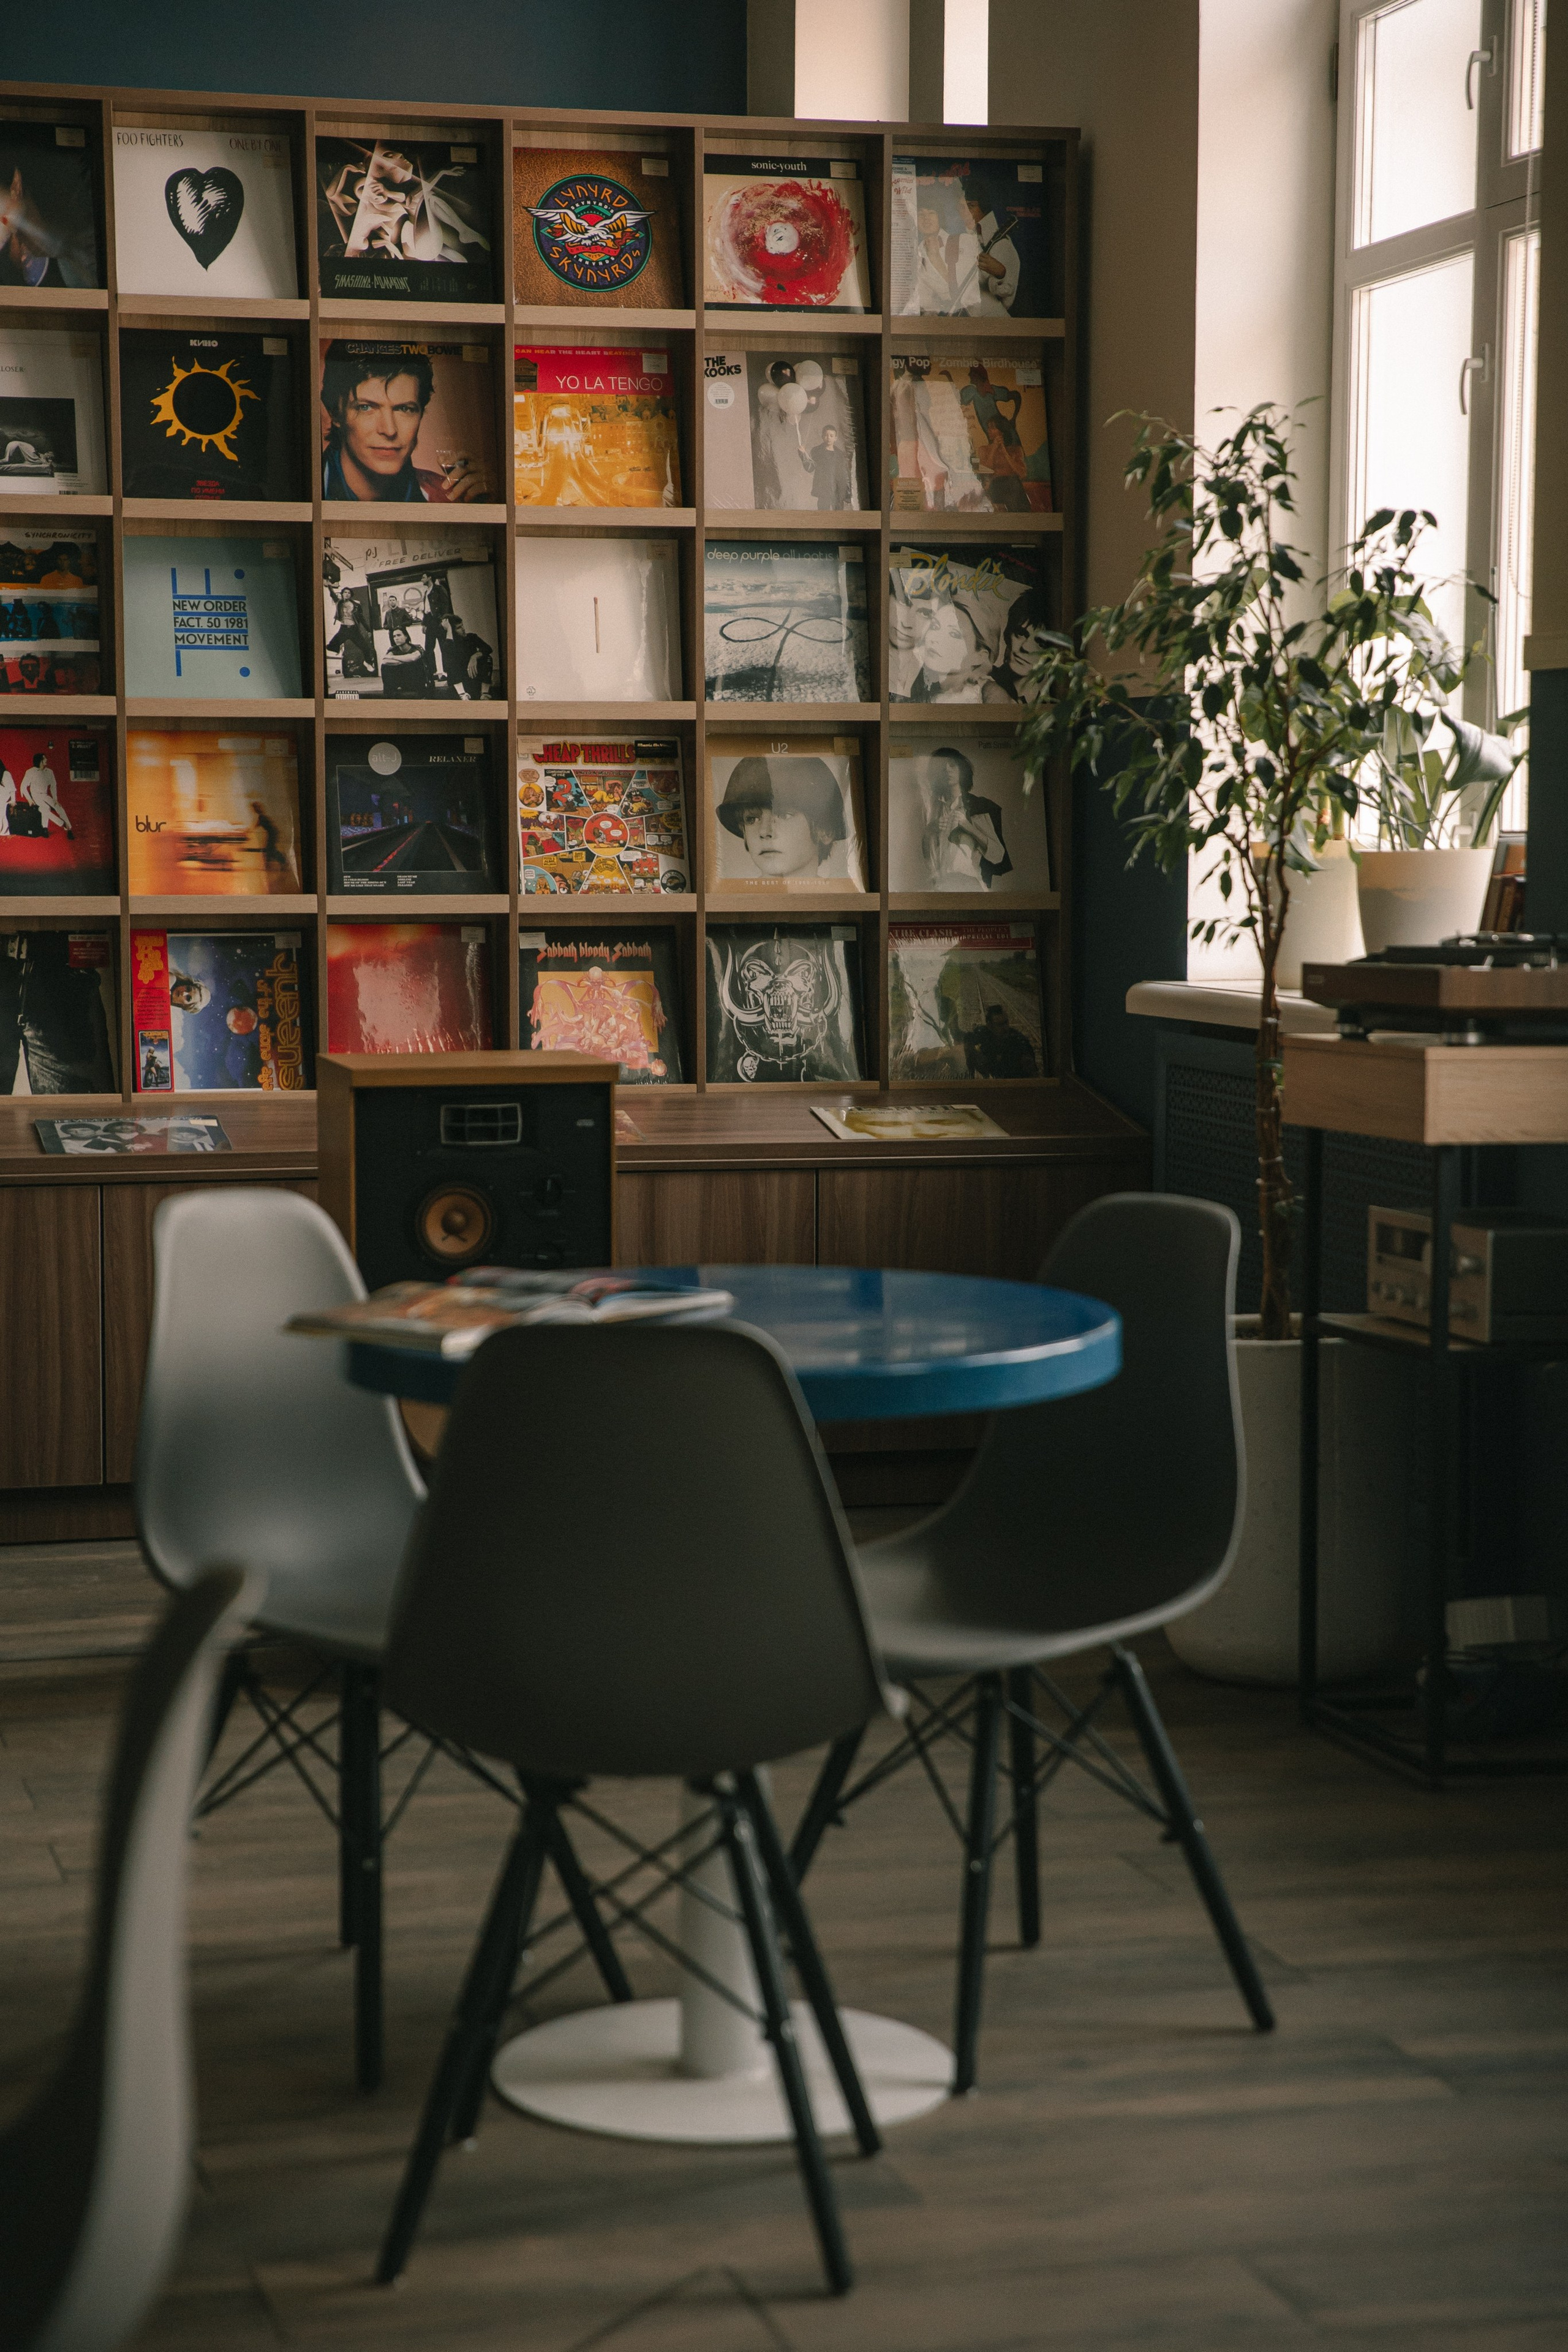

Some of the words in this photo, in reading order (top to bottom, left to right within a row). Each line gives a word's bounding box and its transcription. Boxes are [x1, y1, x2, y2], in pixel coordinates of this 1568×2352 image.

[117, 132, 138, 146] FOO
[140, 133, 183, 148] FIGHTERS
[229, 137, 249, 151] ONE
[250, 140, 262, 151] BY
[263, 138, 282, 153] ONE
[752, 160, 807, 172] sonic-youth
[554, 184, 628, 208] LYNYRD
[571, 200, 614, 214] SKYNYRD'S
[334, 274, 372, 289] SMASHING
[704, 356, 726, 367] THE
[909, 357, 930, 368] Pop
[556, 375, 579, 390] YO
[584, 376, 605, 390] LA
[608, 376, 663, 391] TENGO
[378, 557, 406, 568] FREE
[707, 548, 738, 564] deep
[740, 549, 780, 564] purple
[905, 553, 1010, 601] Blondie
[173, 600, 201, 611] NEW
[203, 600, 247, 611] ORDER
[173, 616, 203, 628] FACT.
[206, 617, 221, 628] 50
[224, 617, 248, 628] 1981
[175, 633, 249, 645] MOVEMENT
[581, 744, 636, 764] THRILLS
[771, 742, 789, 754] U2
[372, 753, 397, 763] alt-J
[135, 815, 167, 832] blur
[919, 929, 953, 937] CLASH
[536, 941, 578, 963] Sabbath
[579, 941, 610, 963] bloody
[612, 941, 652, 963] Sabbath
[265, 952, 304, 1090] queens
